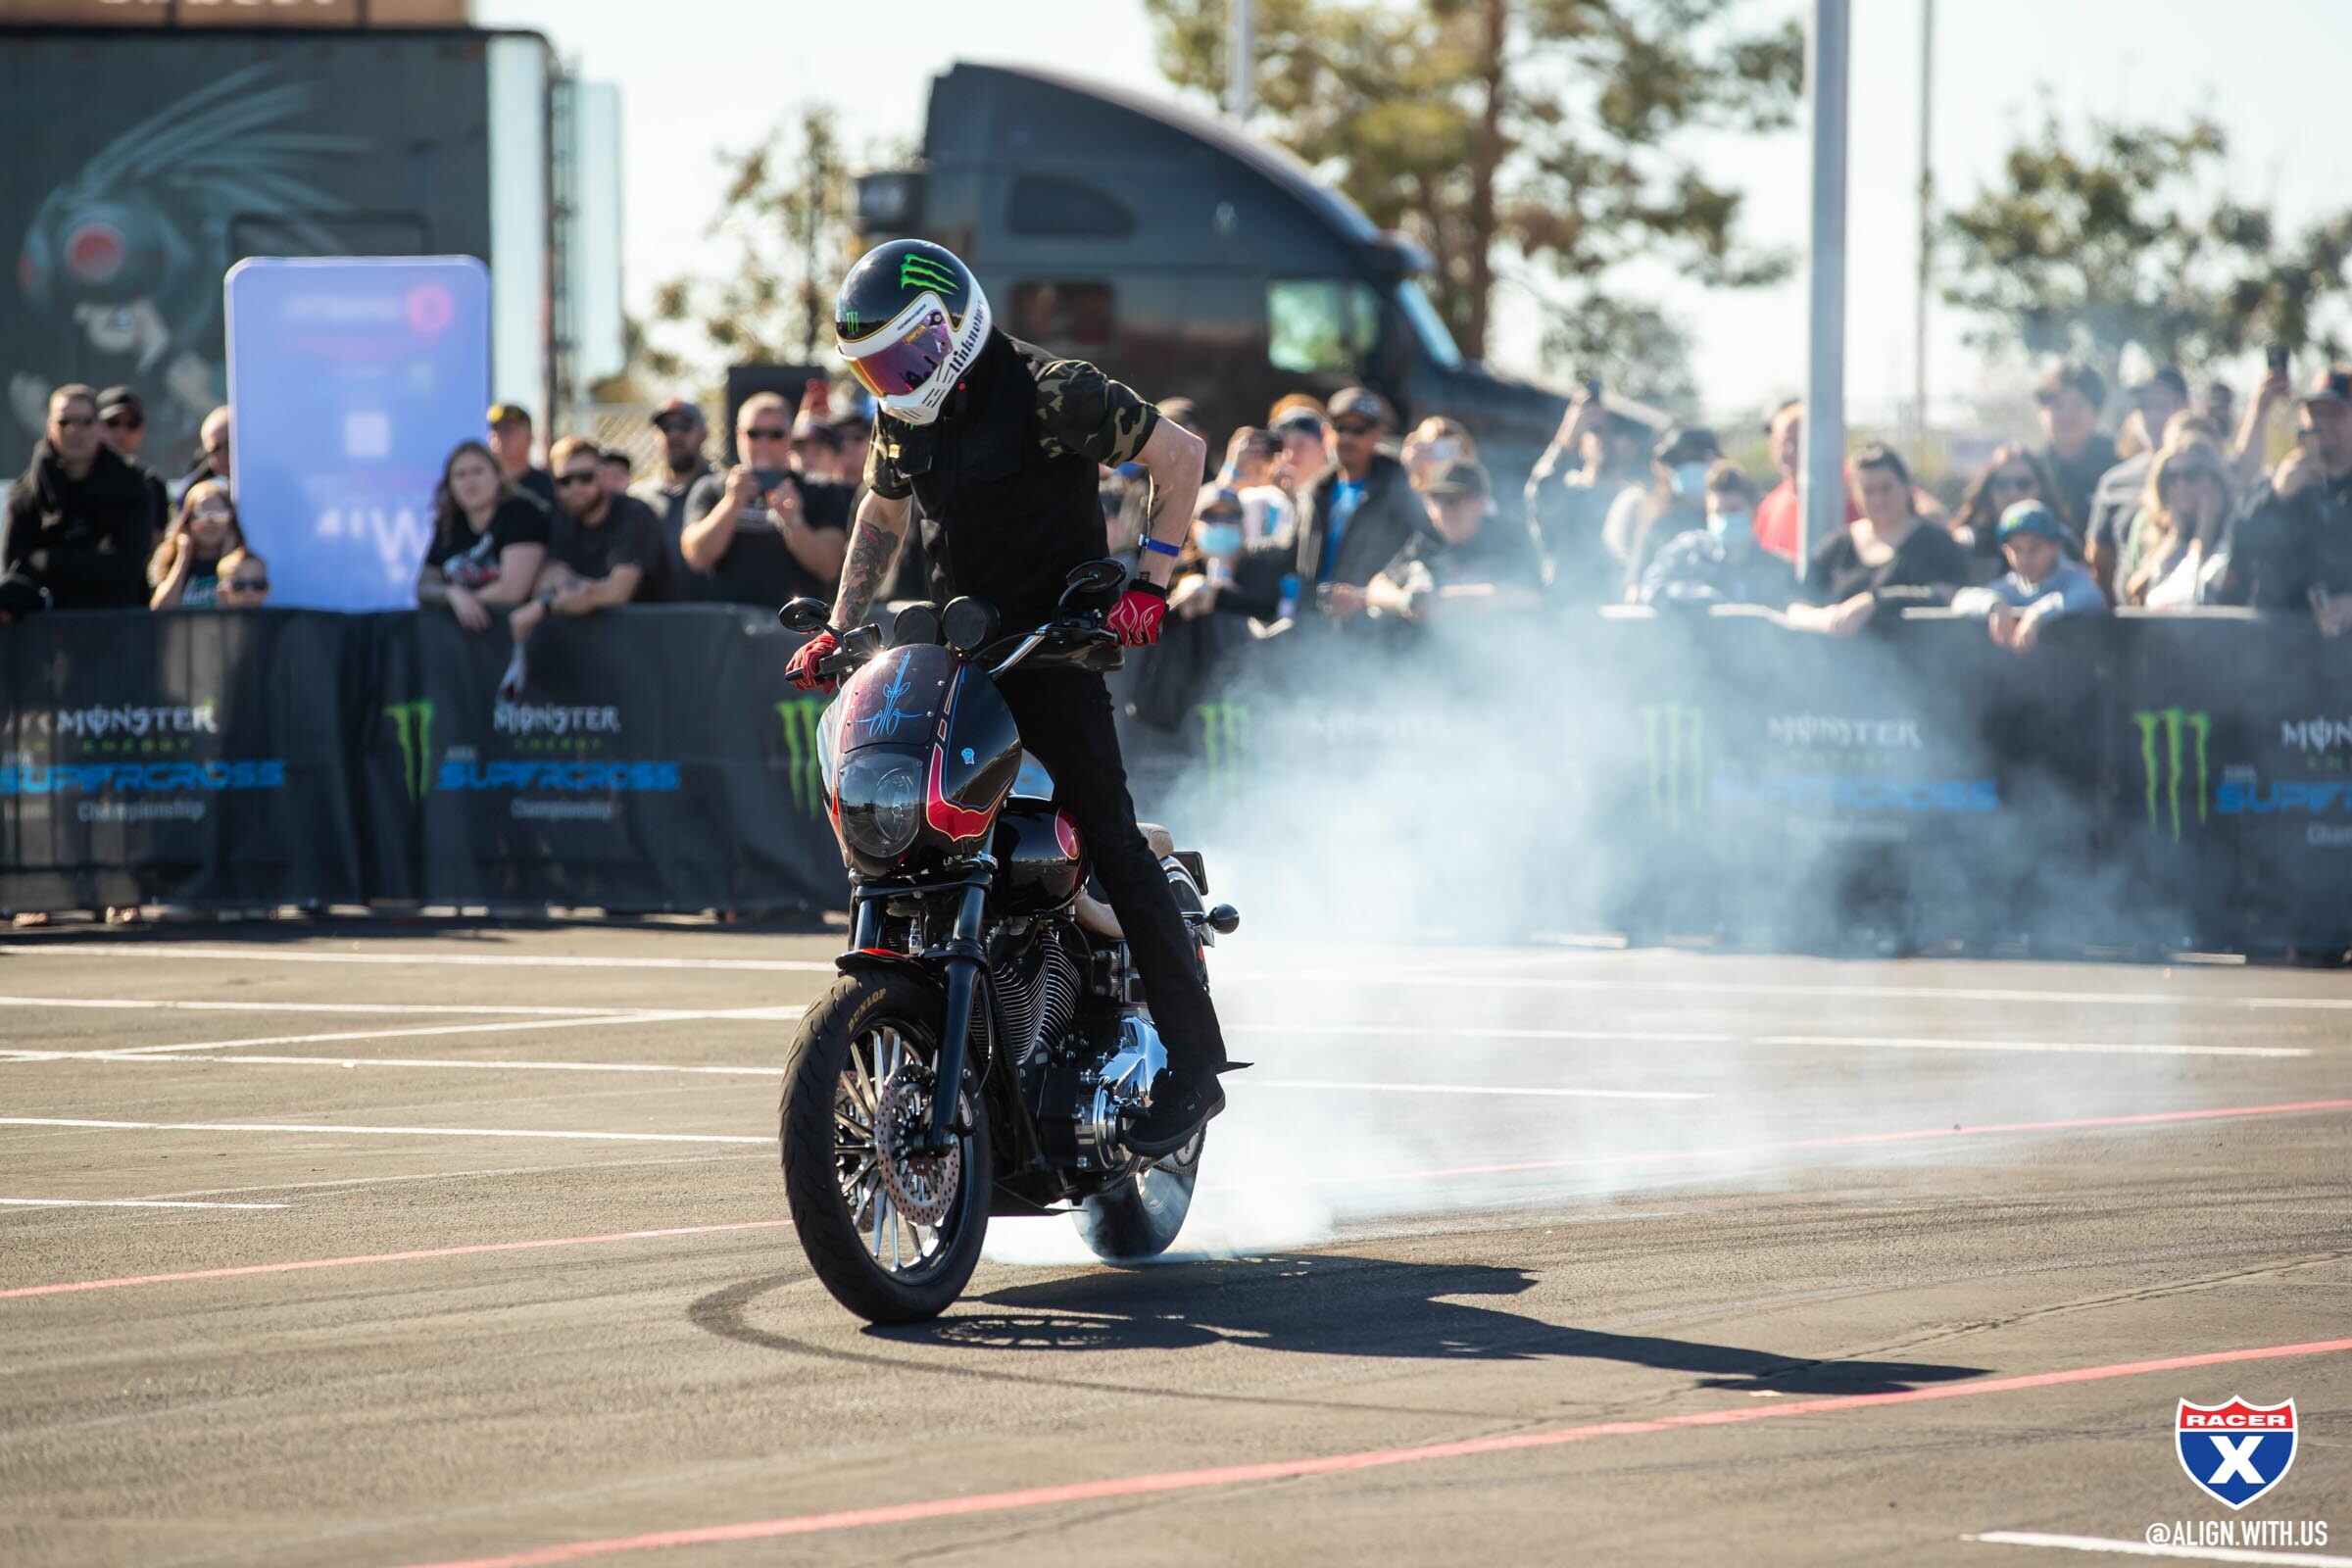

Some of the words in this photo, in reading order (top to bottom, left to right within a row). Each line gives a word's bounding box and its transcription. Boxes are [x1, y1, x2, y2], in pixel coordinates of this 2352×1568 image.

[57, 704, 219, 736] MONSTER
[493, 705, 621, 733] MONSTER
[849, 988, 887, 1034] DUNLOP
